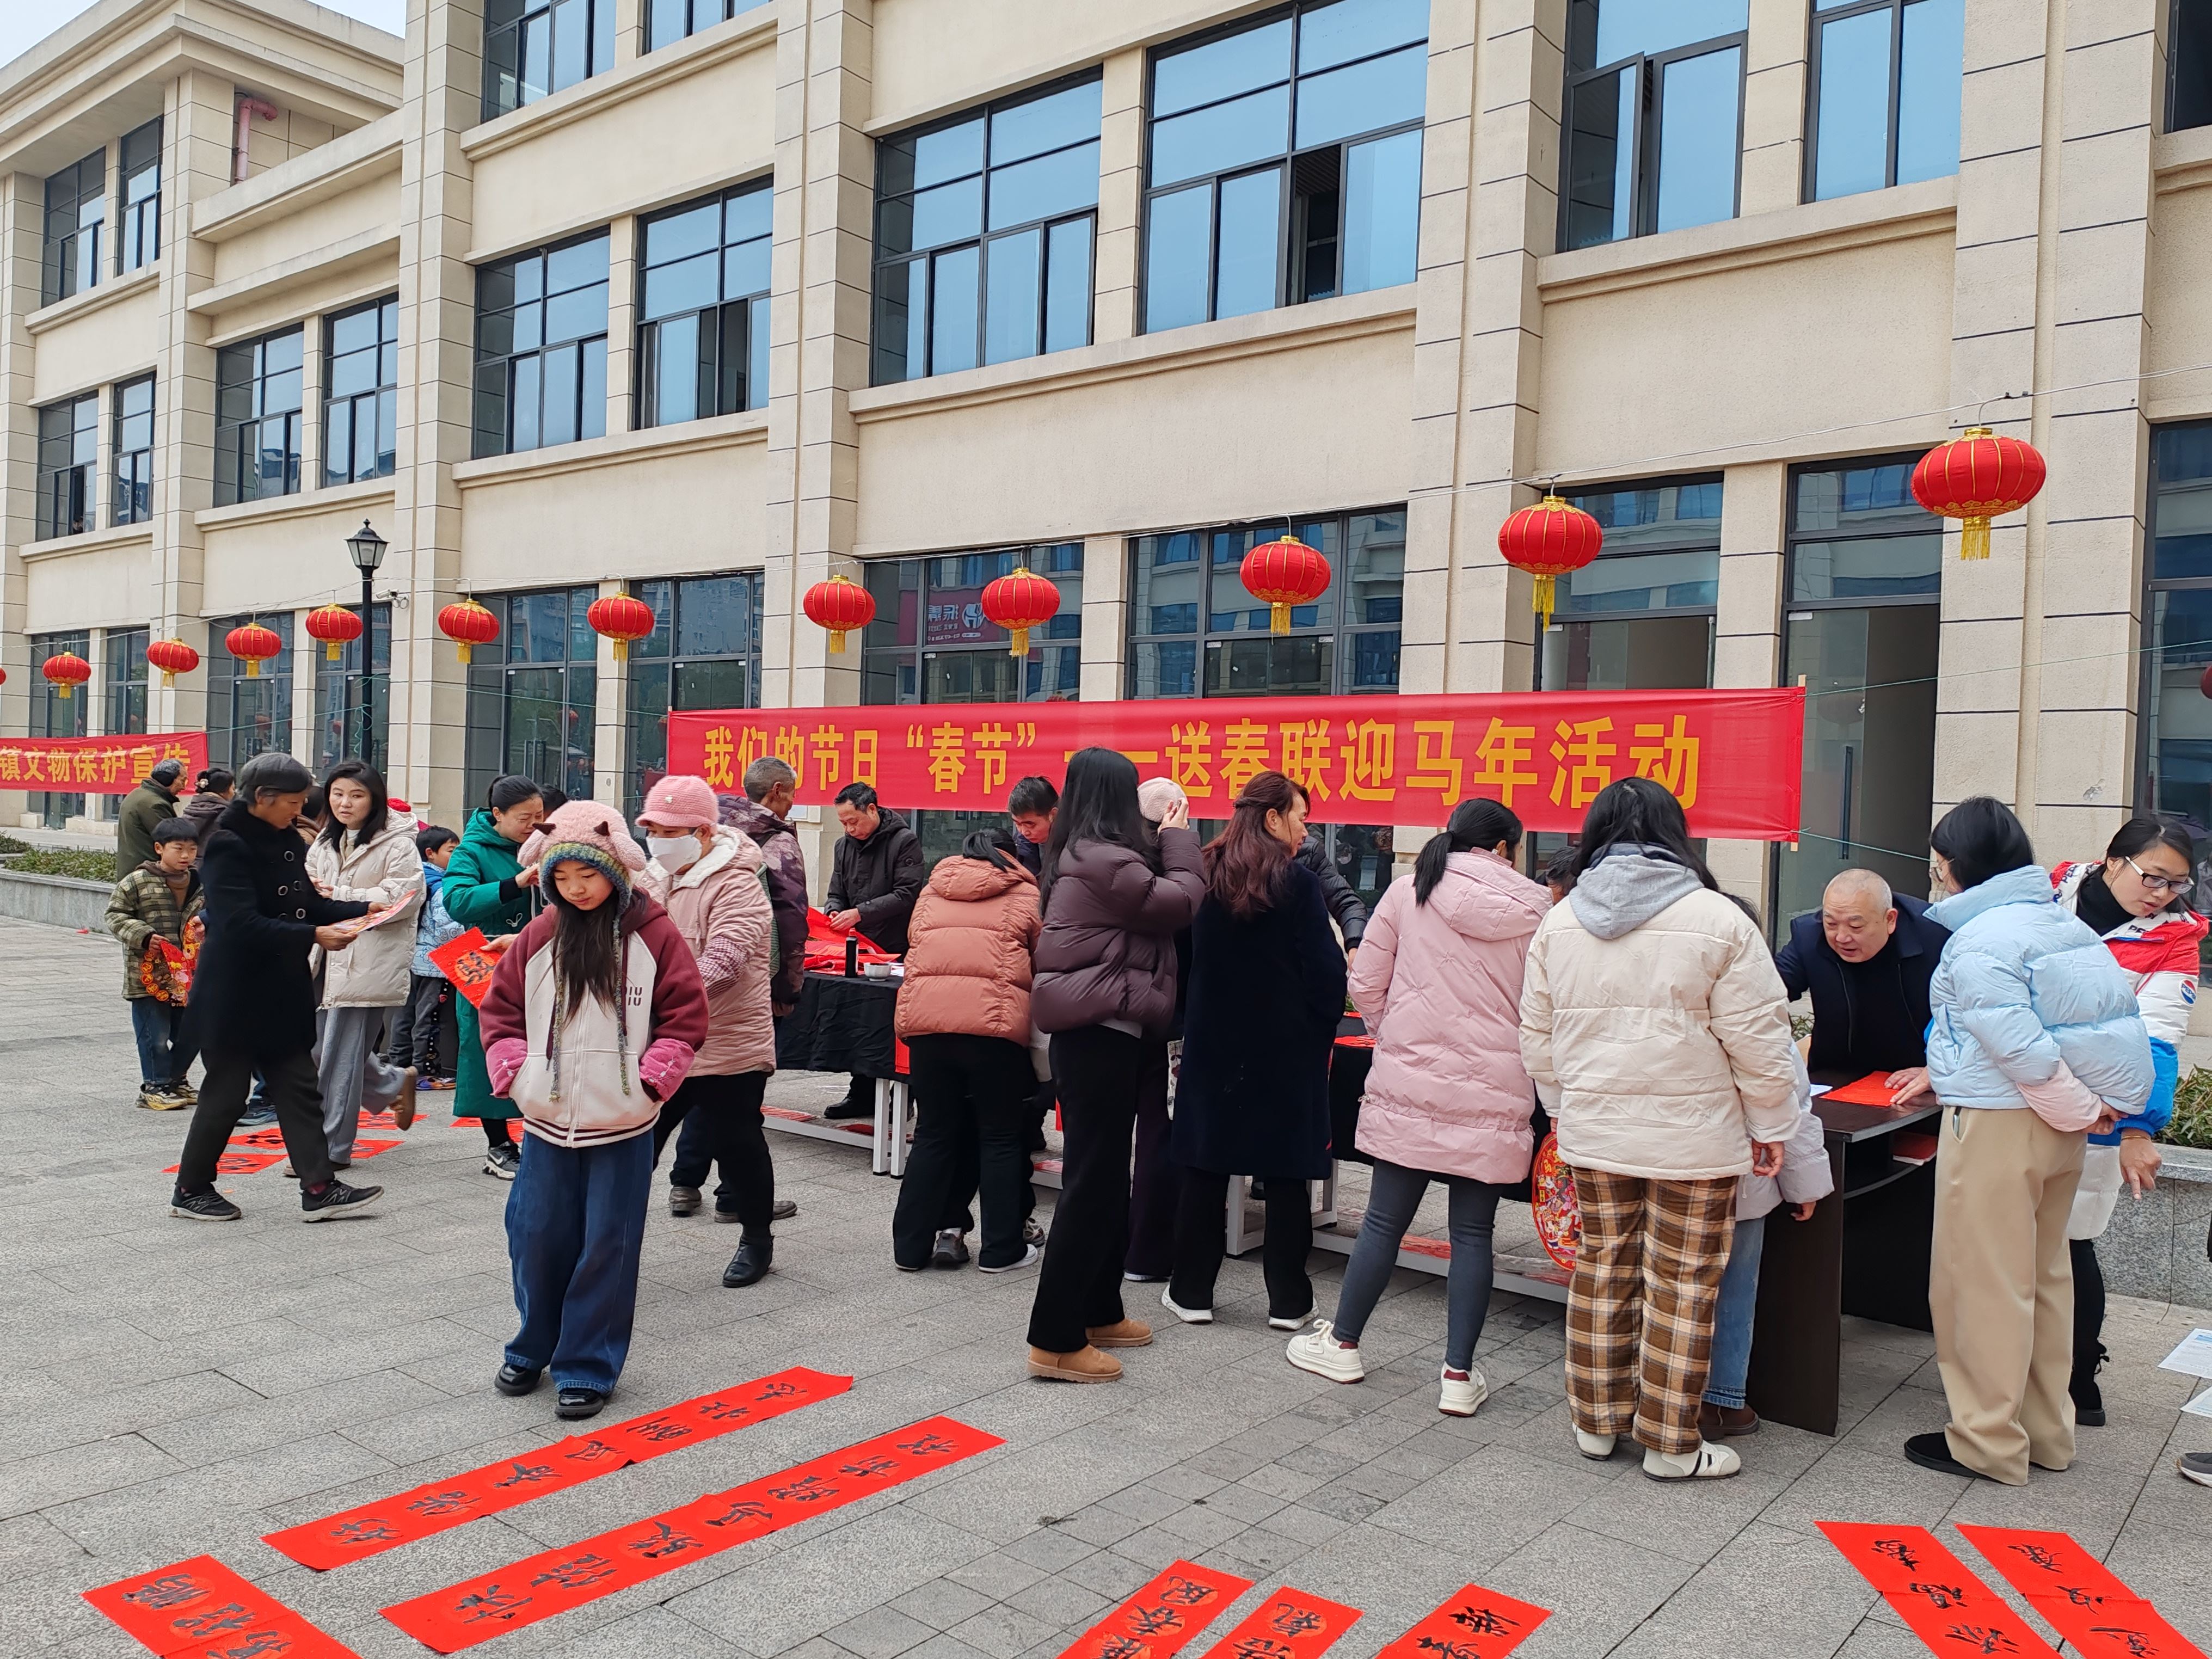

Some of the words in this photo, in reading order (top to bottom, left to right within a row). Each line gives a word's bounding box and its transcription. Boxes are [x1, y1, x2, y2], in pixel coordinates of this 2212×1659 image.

[704, 714, 1699, 810] 我们的节日“春节”送春联迎马年活动
[629, 986, 643, 996] IU
[628, 996, 642, 1006] IU
